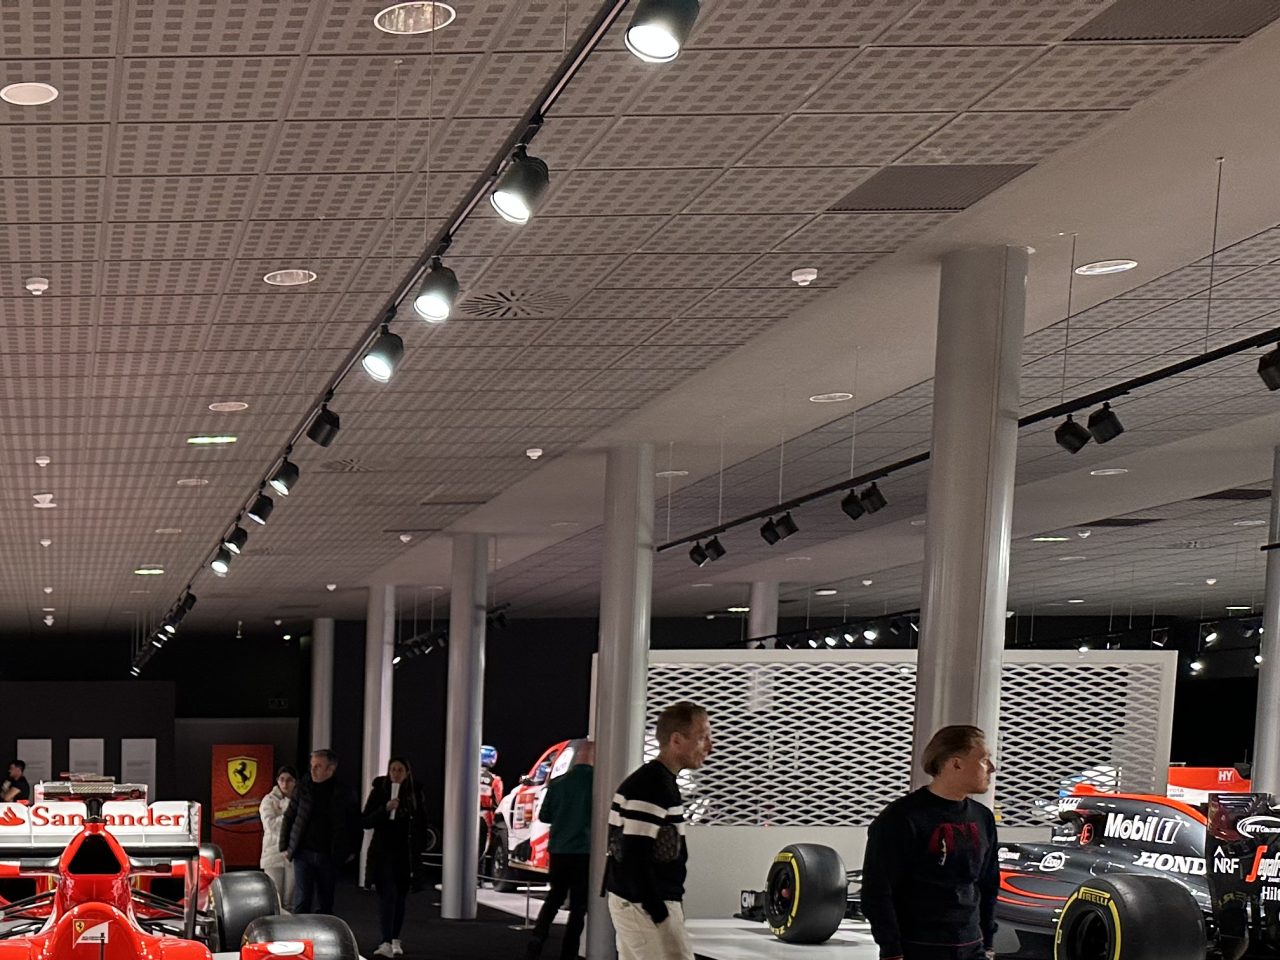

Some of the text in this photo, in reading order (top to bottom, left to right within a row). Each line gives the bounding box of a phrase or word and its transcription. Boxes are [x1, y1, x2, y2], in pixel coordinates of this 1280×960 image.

[1219, 770, 1234, 782] HY
[32, 805, 185, 827] Sanander
[1104, 812, 1159, 842] Mobil
[1133, 851, 1207, 875] HOND
[1214, 858, 1240, 874] NRF
[1245, 845, 1280, 883] Segaf
[1078, 886, 1111, 906] PIRELLI
